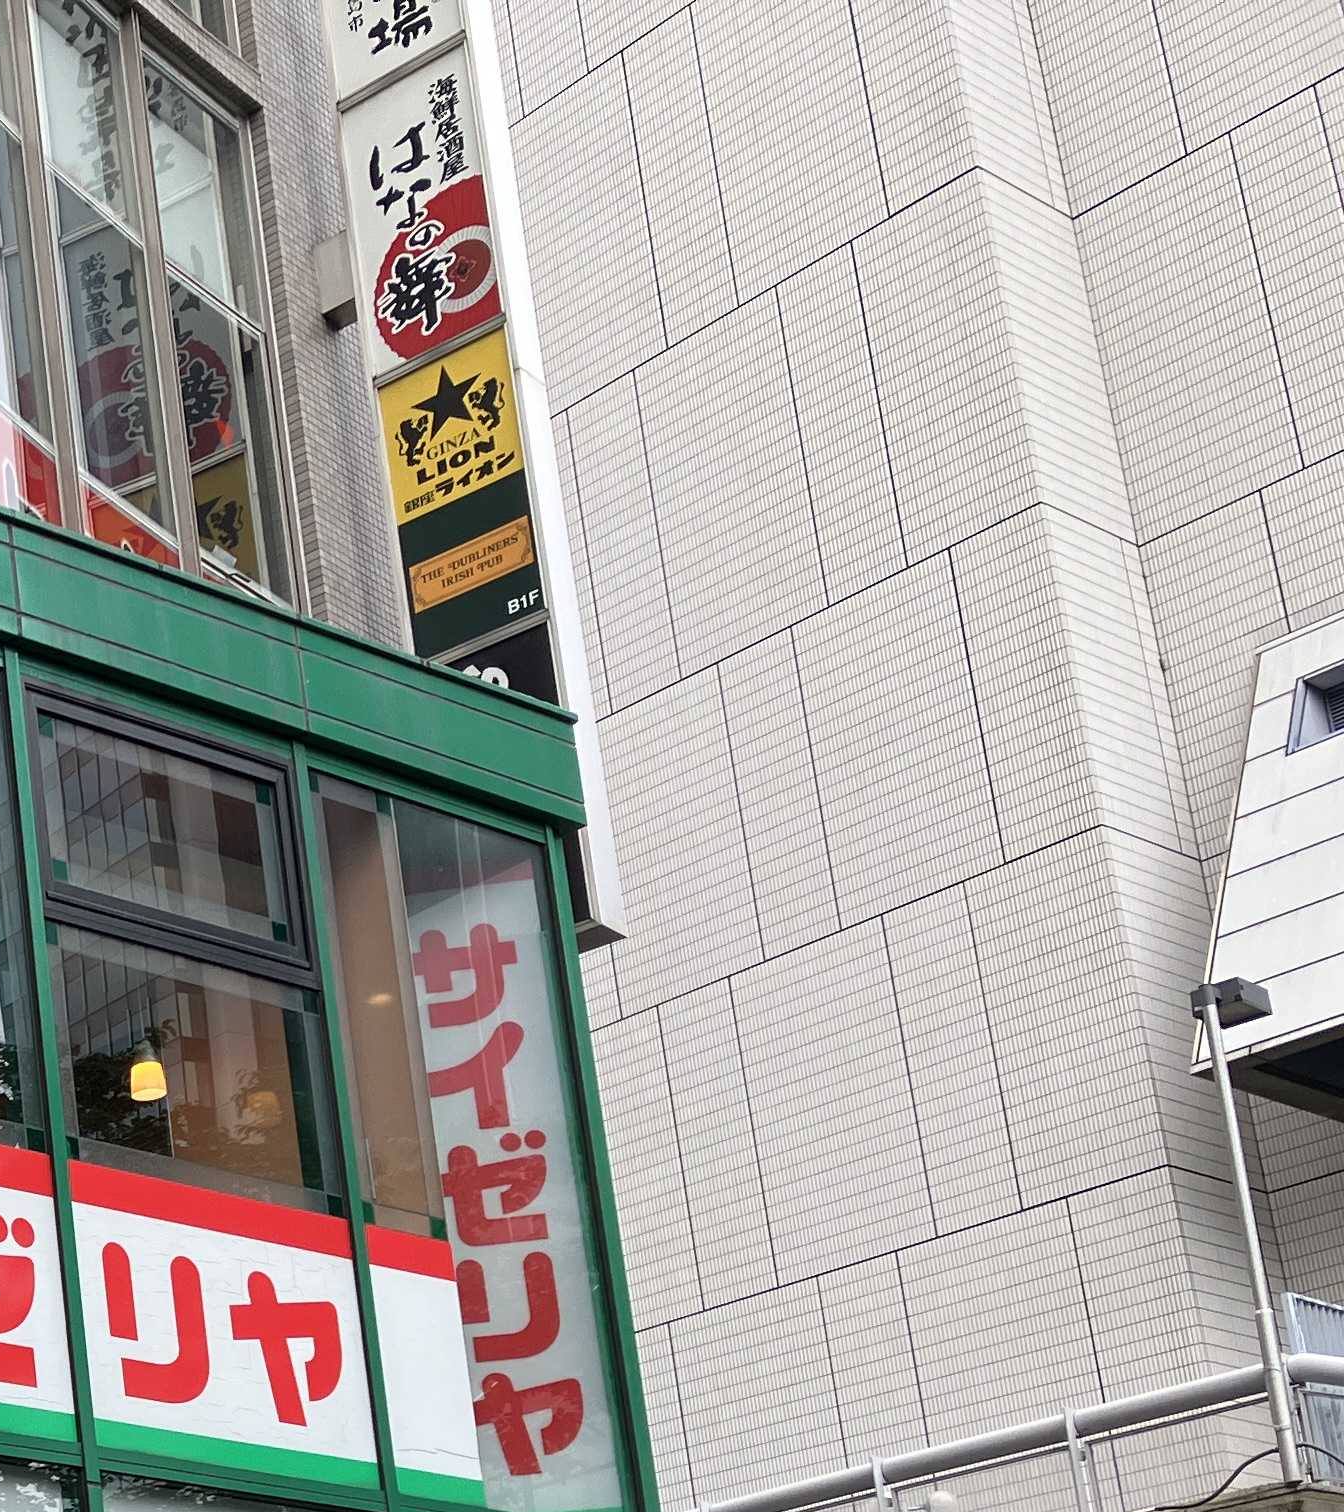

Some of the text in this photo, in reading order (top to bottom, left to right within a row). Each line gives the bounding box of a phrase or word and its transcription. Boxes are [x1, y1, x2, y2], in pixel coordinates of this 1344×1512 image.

[428, 73, 470, 185] 海鮮居酒屋
[369, 120, 455, 334] はなの舞
[416, 435, 496, 486] LION
[426, 427, 481, 461] GINZA
[421, 567, 445, 585] THE
[441, 553, 504, 589] IRISH PUB
[507, 589, 540, 615] B1F
[411, 921, 585, 1477] サイゼリヤ
